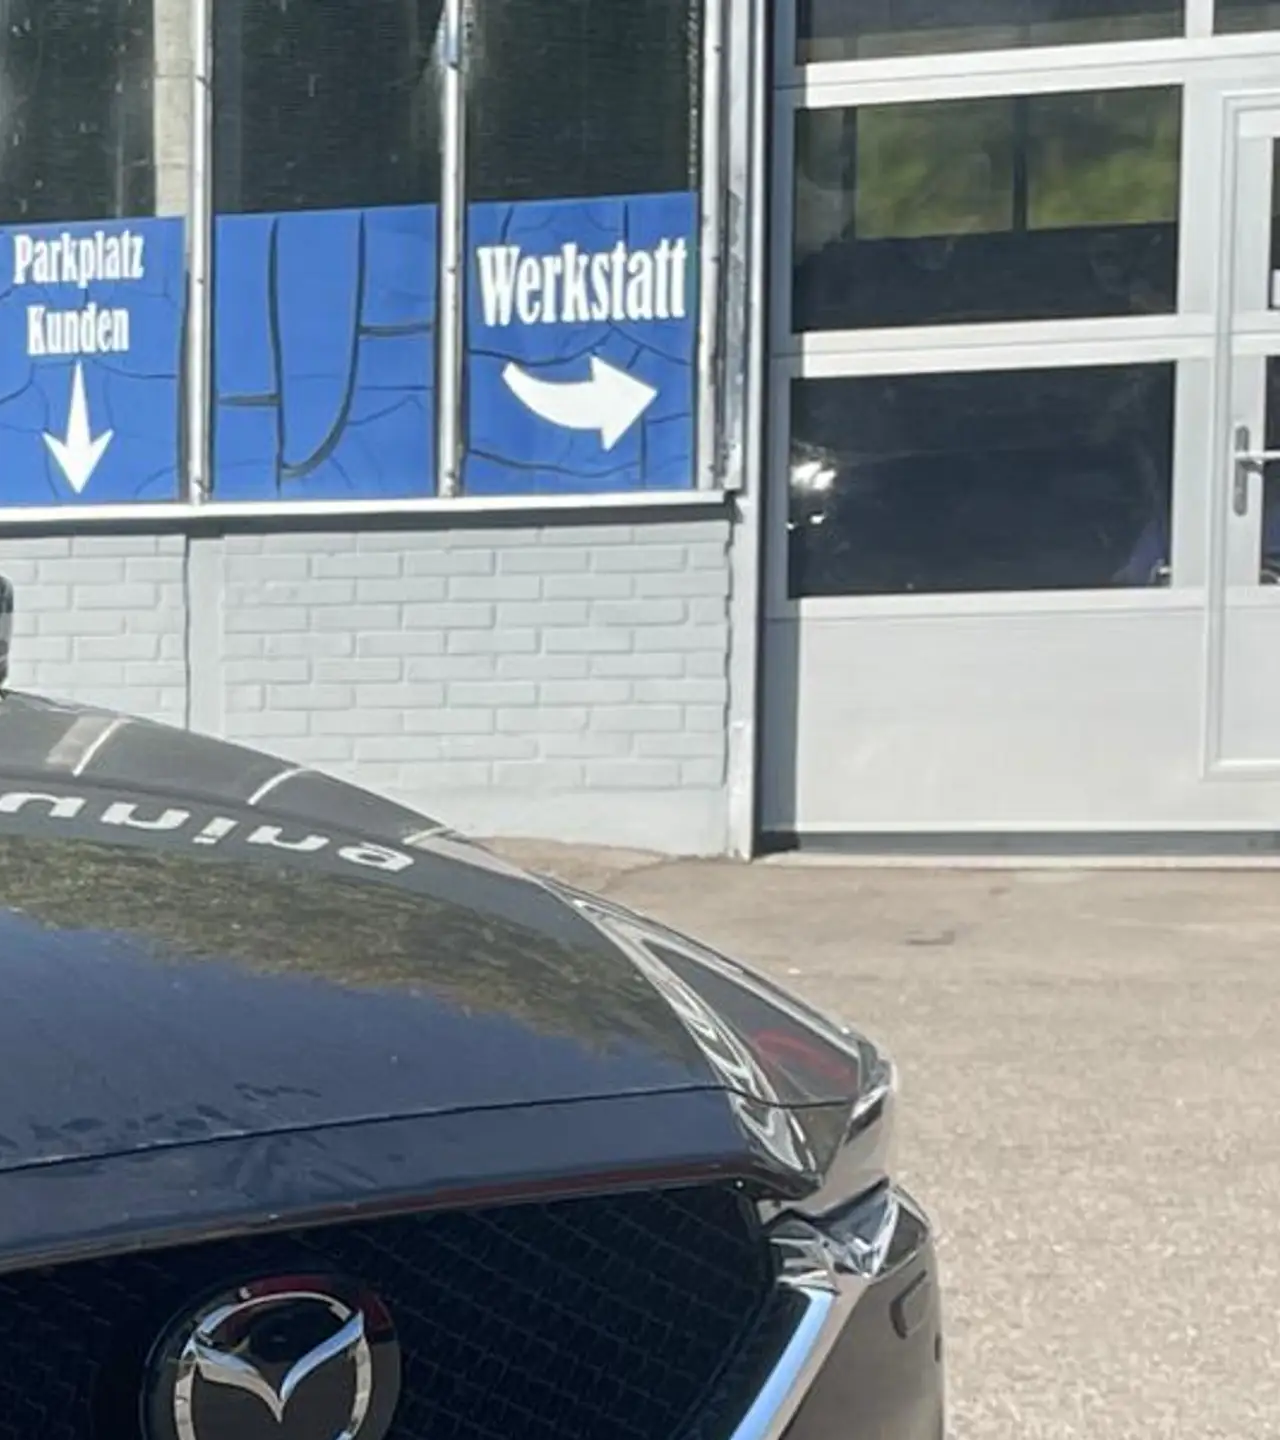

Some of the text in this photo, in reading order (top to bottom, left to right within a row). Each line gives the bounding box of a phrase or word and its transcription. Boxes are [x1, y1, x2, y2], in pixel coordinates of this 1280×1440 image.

[13, 230, 144, 286] Parkplatz
[477, 237, 689, 327] Werkstatt
[27, 306, 129, 356] Kunden
